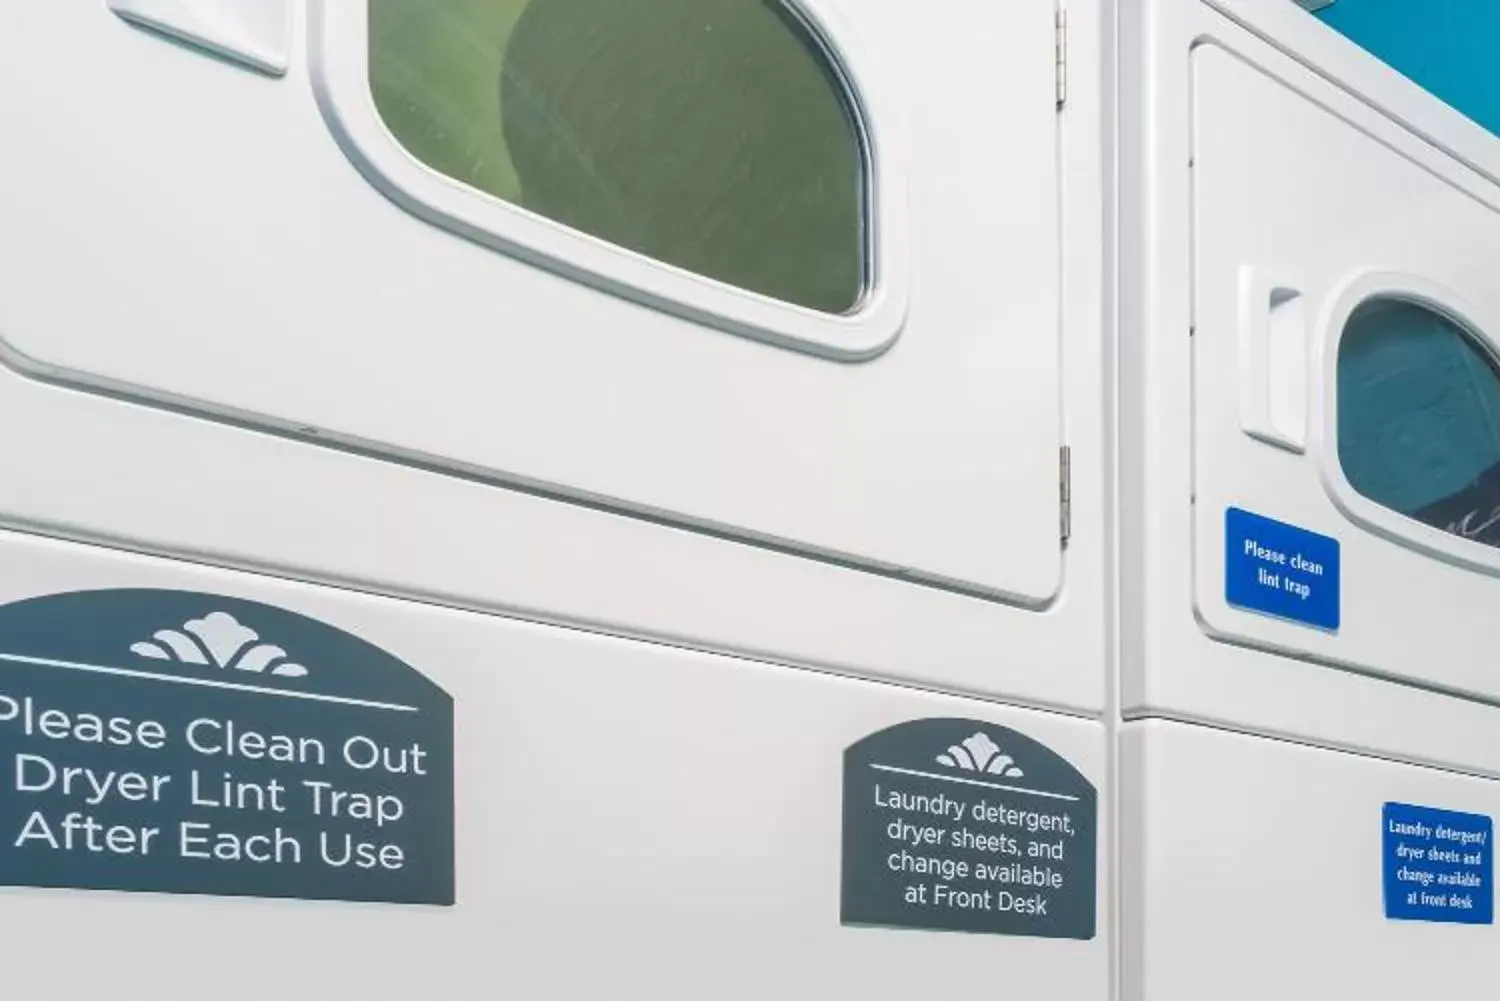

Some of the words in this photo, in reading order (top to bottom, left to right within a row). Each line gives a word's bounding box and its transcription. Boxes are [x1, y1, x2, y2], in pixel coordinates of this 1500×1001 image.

[1245, 539, 1285, 565] Please
[1290, 554, 1323, 575] clean
[1259, 568, 1279, 588] lint
[1285, 577, 1310, 599] trap
[186, 718, 324, 764] Clean
[343, 736, 427, 775] Out
[16, 754, 171, 804] Dryer
[192, 770, 285, 812] Lint
[303, 781, 403, 827] Trap
[875, 784, 965, 821] Laundry
[972, 800, 1075, 835] detergent,
[15, 811, 159, 854] After
[181, 822, 301, 863] Each
[321, 832, 404, 869] Use
[887, 818, 946, 846] dryer
[951, 827, 1021, 857] sheets,
[1027, 840, 1063, 860] and
[1389, 819, 1432, 840] Laundry
[888, 850, 969, 880] change
[975, 863, 1062, 888] available
[1396, 844, 1425, 861] dryer
[1428, 846, 1460, 863] sheets
[1464, 852, 1481, 865] and
[1397, 866, 1434, 886] change
[1437, 872, 1481, 886] available
[905, 884, 927, 904] at
[934, 884, 992, 910] Front
[999, 891, 1047, 915] Desk
[1407, 892, 1417, 904] at
[1421, 891, 1446, 906] front
[1449, 893, 1472, 909] desk
